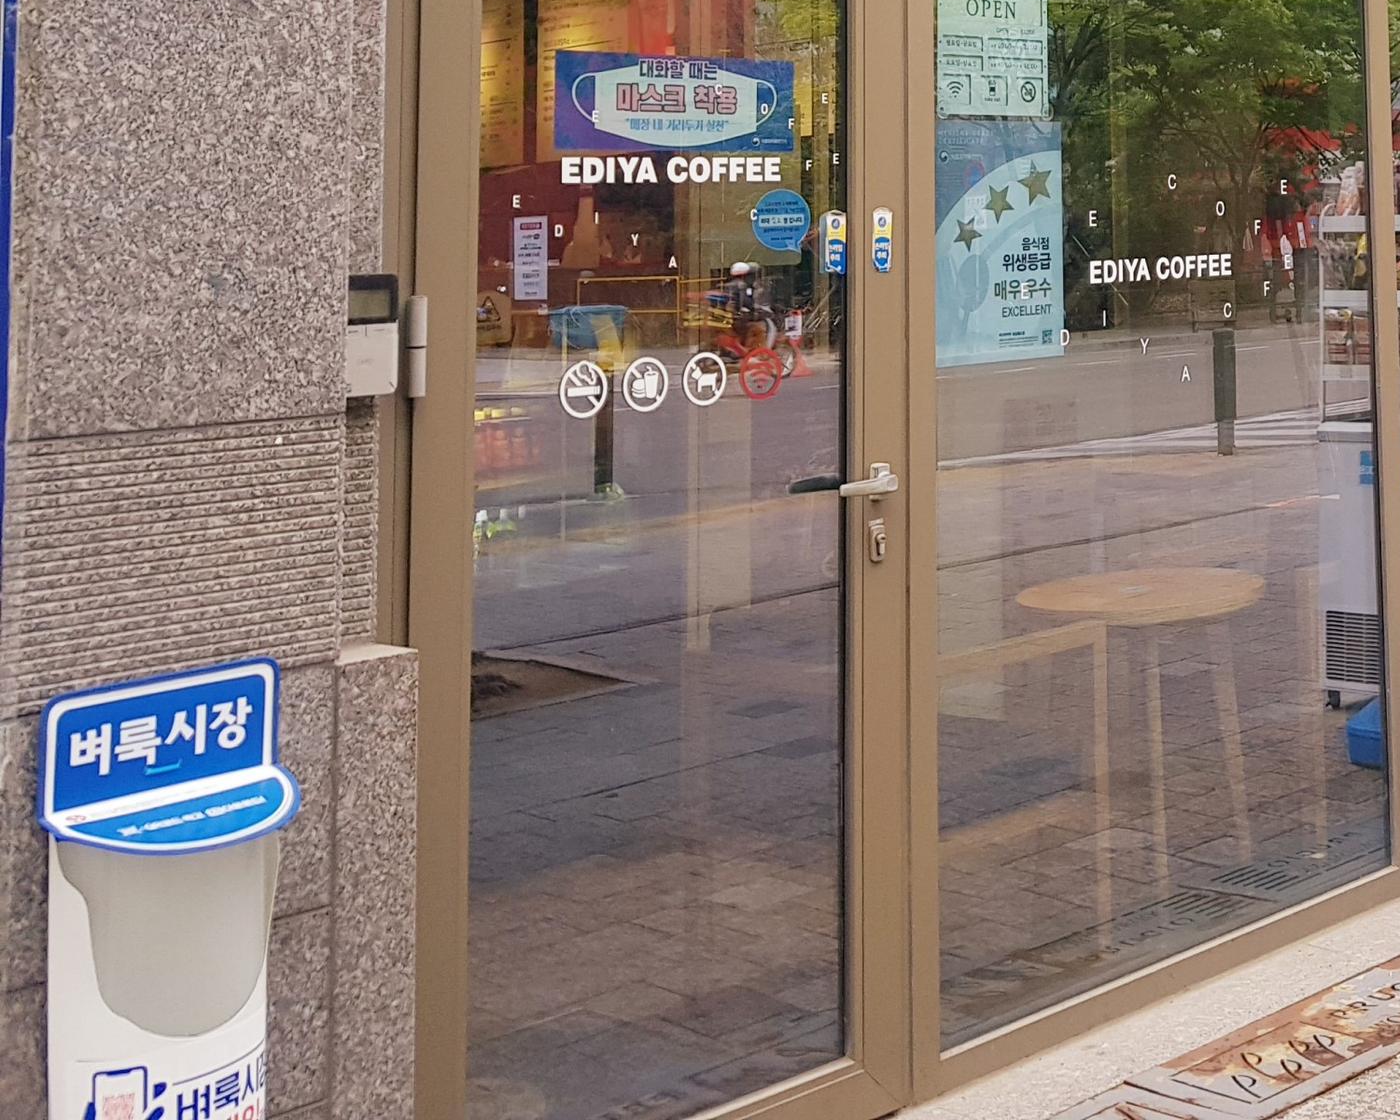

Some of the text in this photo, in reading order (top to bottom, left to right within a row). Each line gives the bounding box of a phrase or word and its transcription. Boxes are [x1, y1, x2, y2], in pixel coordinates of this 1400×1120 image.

[639, 59, 718, 81] 대화할 때는
[616, 83, 737, 115] 마스크 착용
[561, 156, 781, 184] EDIYA COFFEE
[1021, 237, 1050, 251] 음식점
[1002, 253, 1052, 272] 위생등급
[1089, 253, 1232, 284] EDIYA COFFEE
[1001, 304, 1052, 318] EXCELLENT
[69, 696, 254, 776] 벼룩시장
